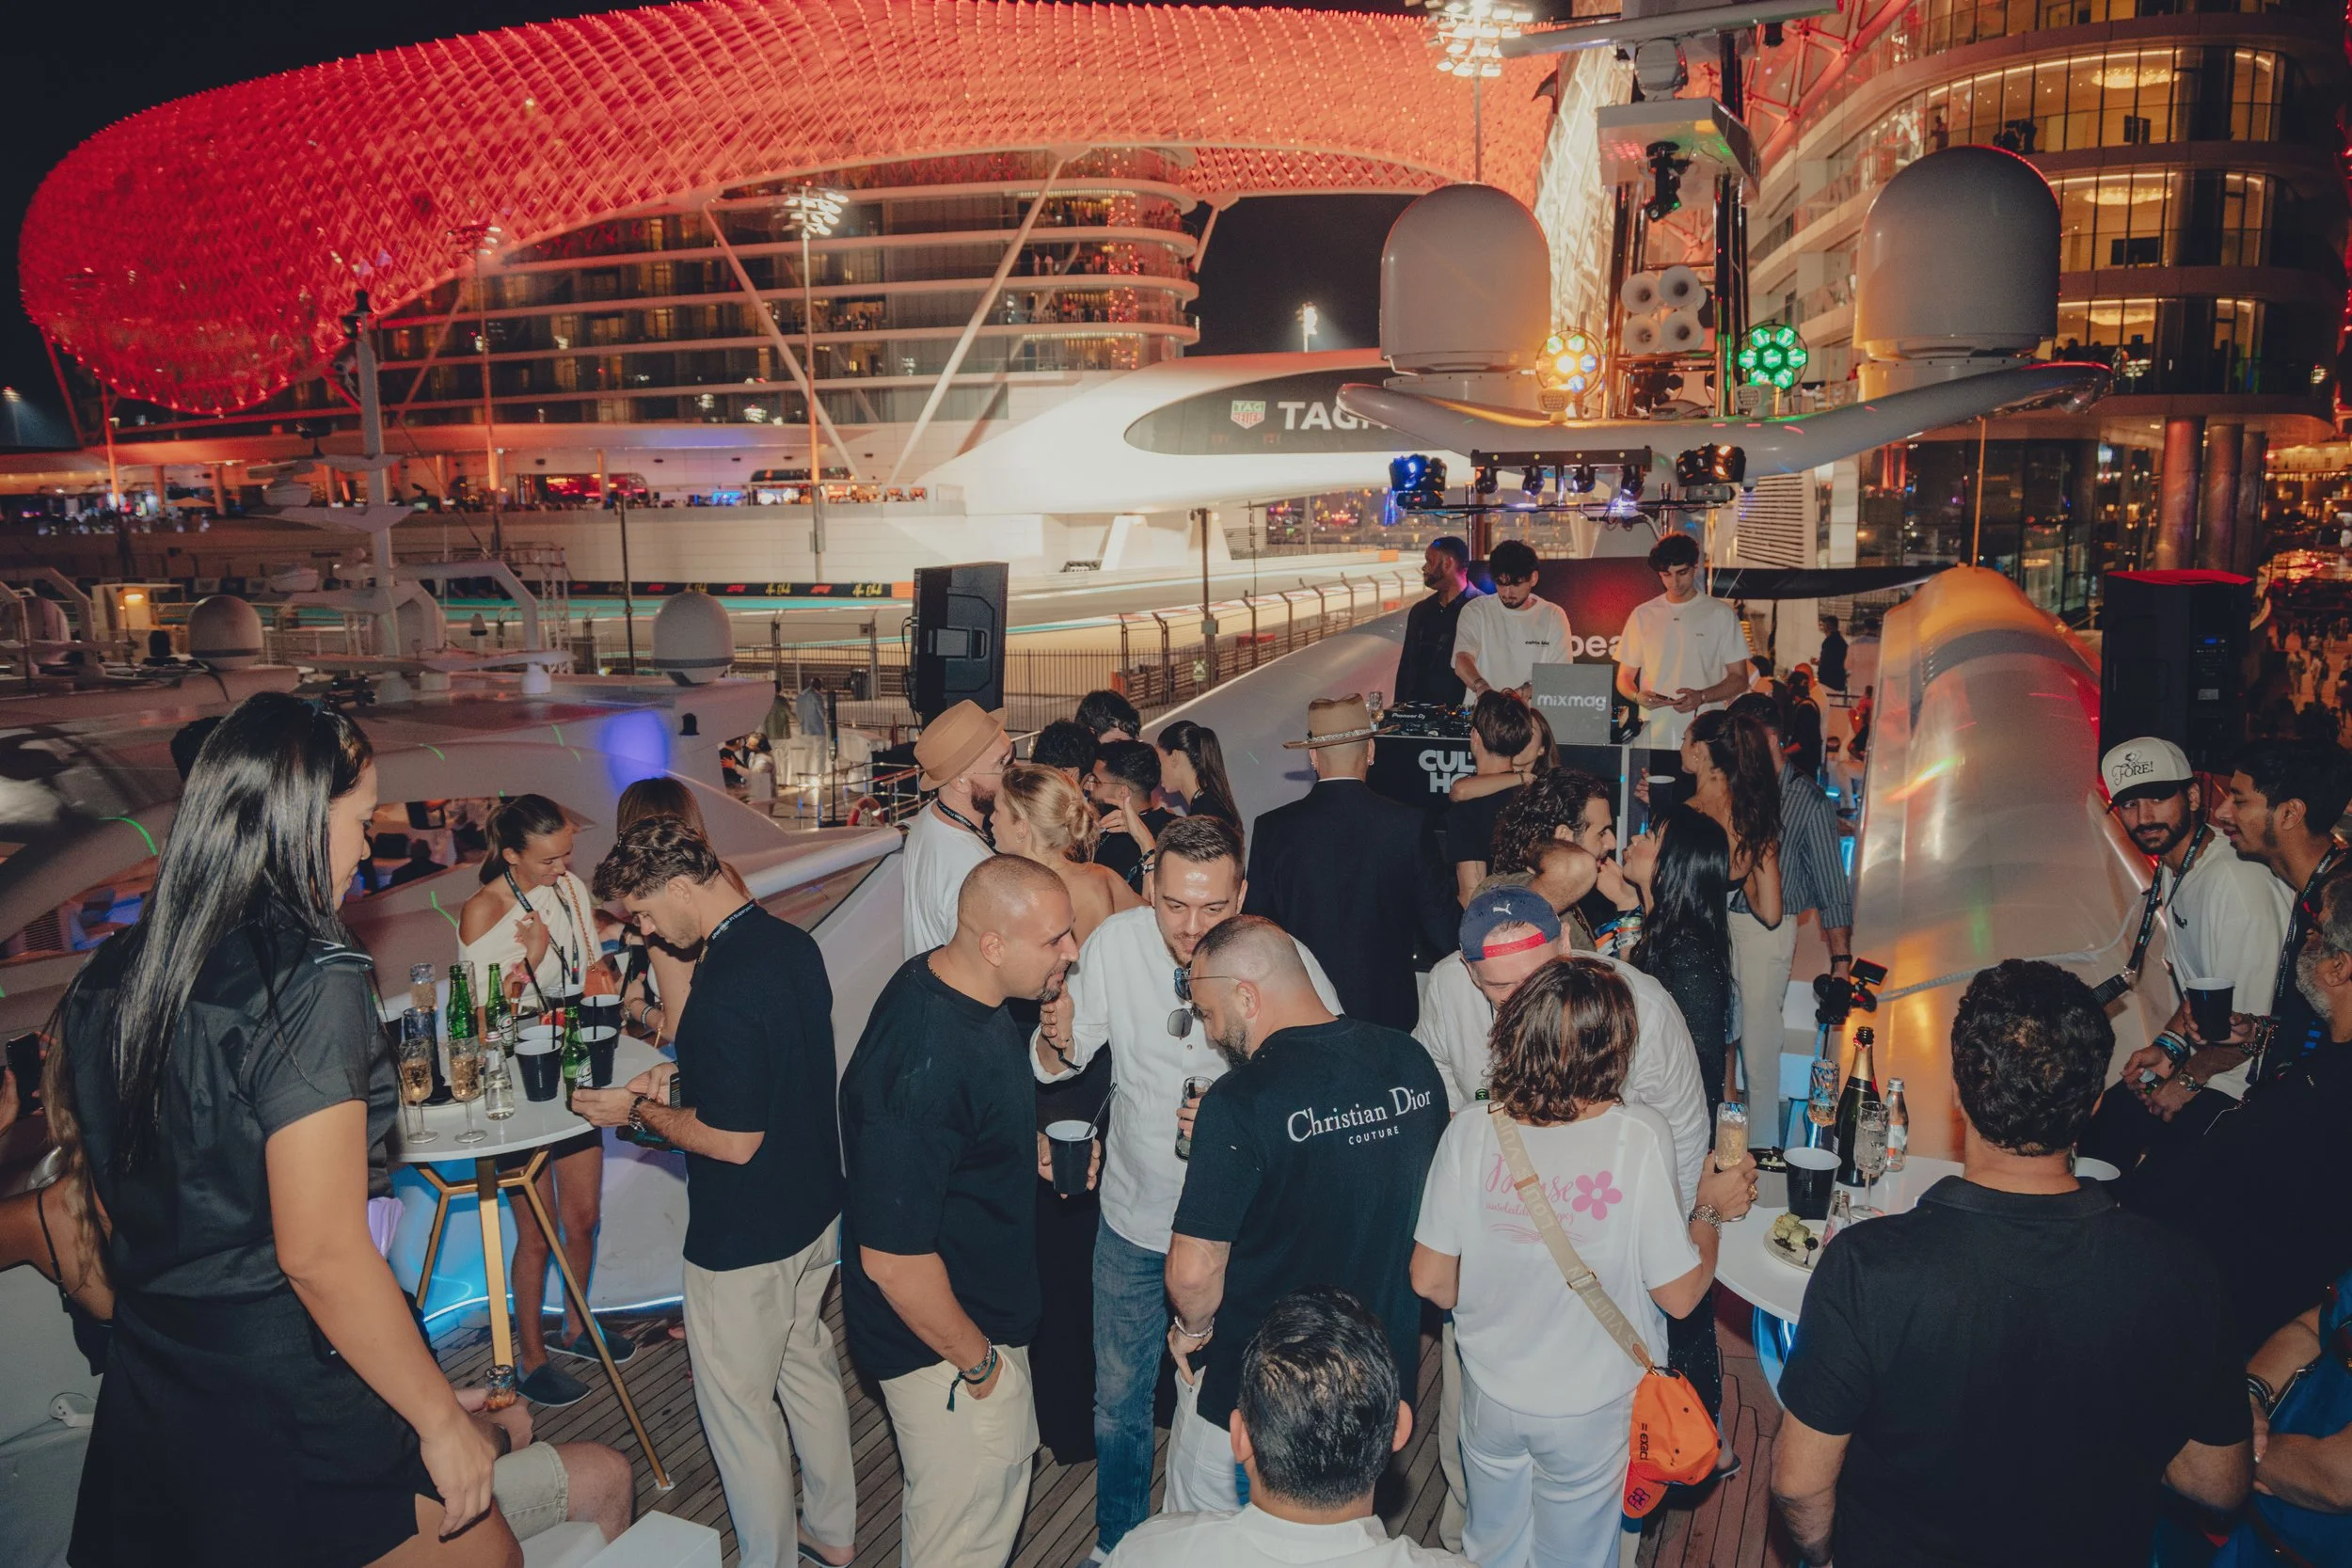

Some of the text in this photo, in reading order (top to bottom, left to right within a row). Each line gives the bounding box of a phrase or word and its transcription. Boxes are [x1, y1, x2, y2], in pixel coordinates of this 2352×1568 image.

[1235, 402, 1263, 412] TAG
[1278, 402, 1370, 430] TAG
[1536, 694, 1607, 712] mixmag
[1418, 749, 1476, 773] CUL
[1287, 1085, 1431, 1143] Christian Dior
[1348, 1125, 1400, 1146] COUTURE
